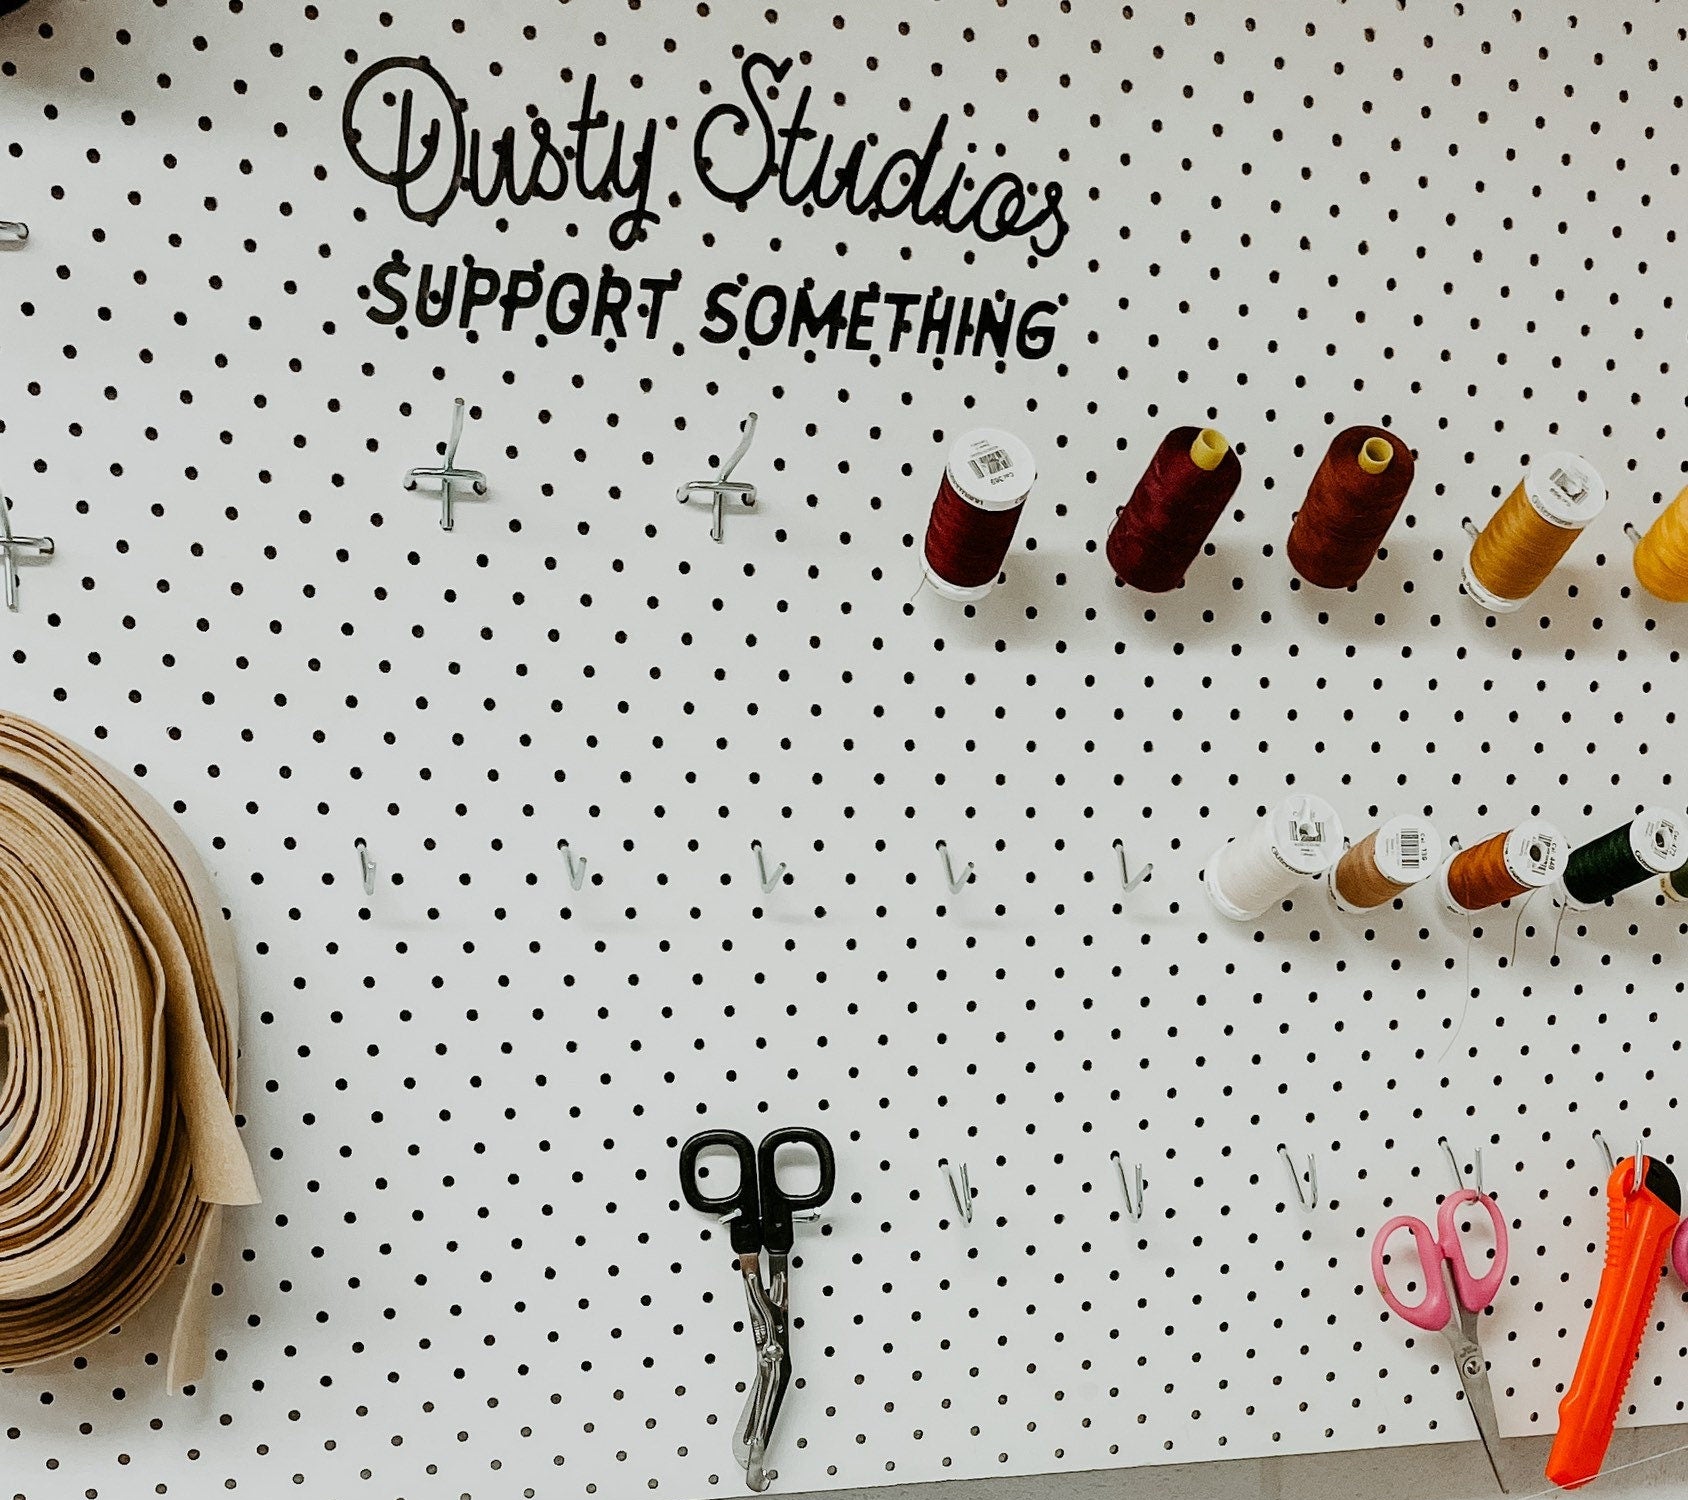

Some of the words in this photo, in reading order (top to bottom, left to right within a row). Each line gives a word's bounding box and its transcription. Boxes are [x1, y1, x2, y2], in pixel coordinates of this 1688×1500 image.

[343, 56, 662, 250] Dusty
[694, 53, 1069, 258] Studios
[366, 260, 680, 340] SUPPORT
[700, 281, 1061, 360] SOMETHING
